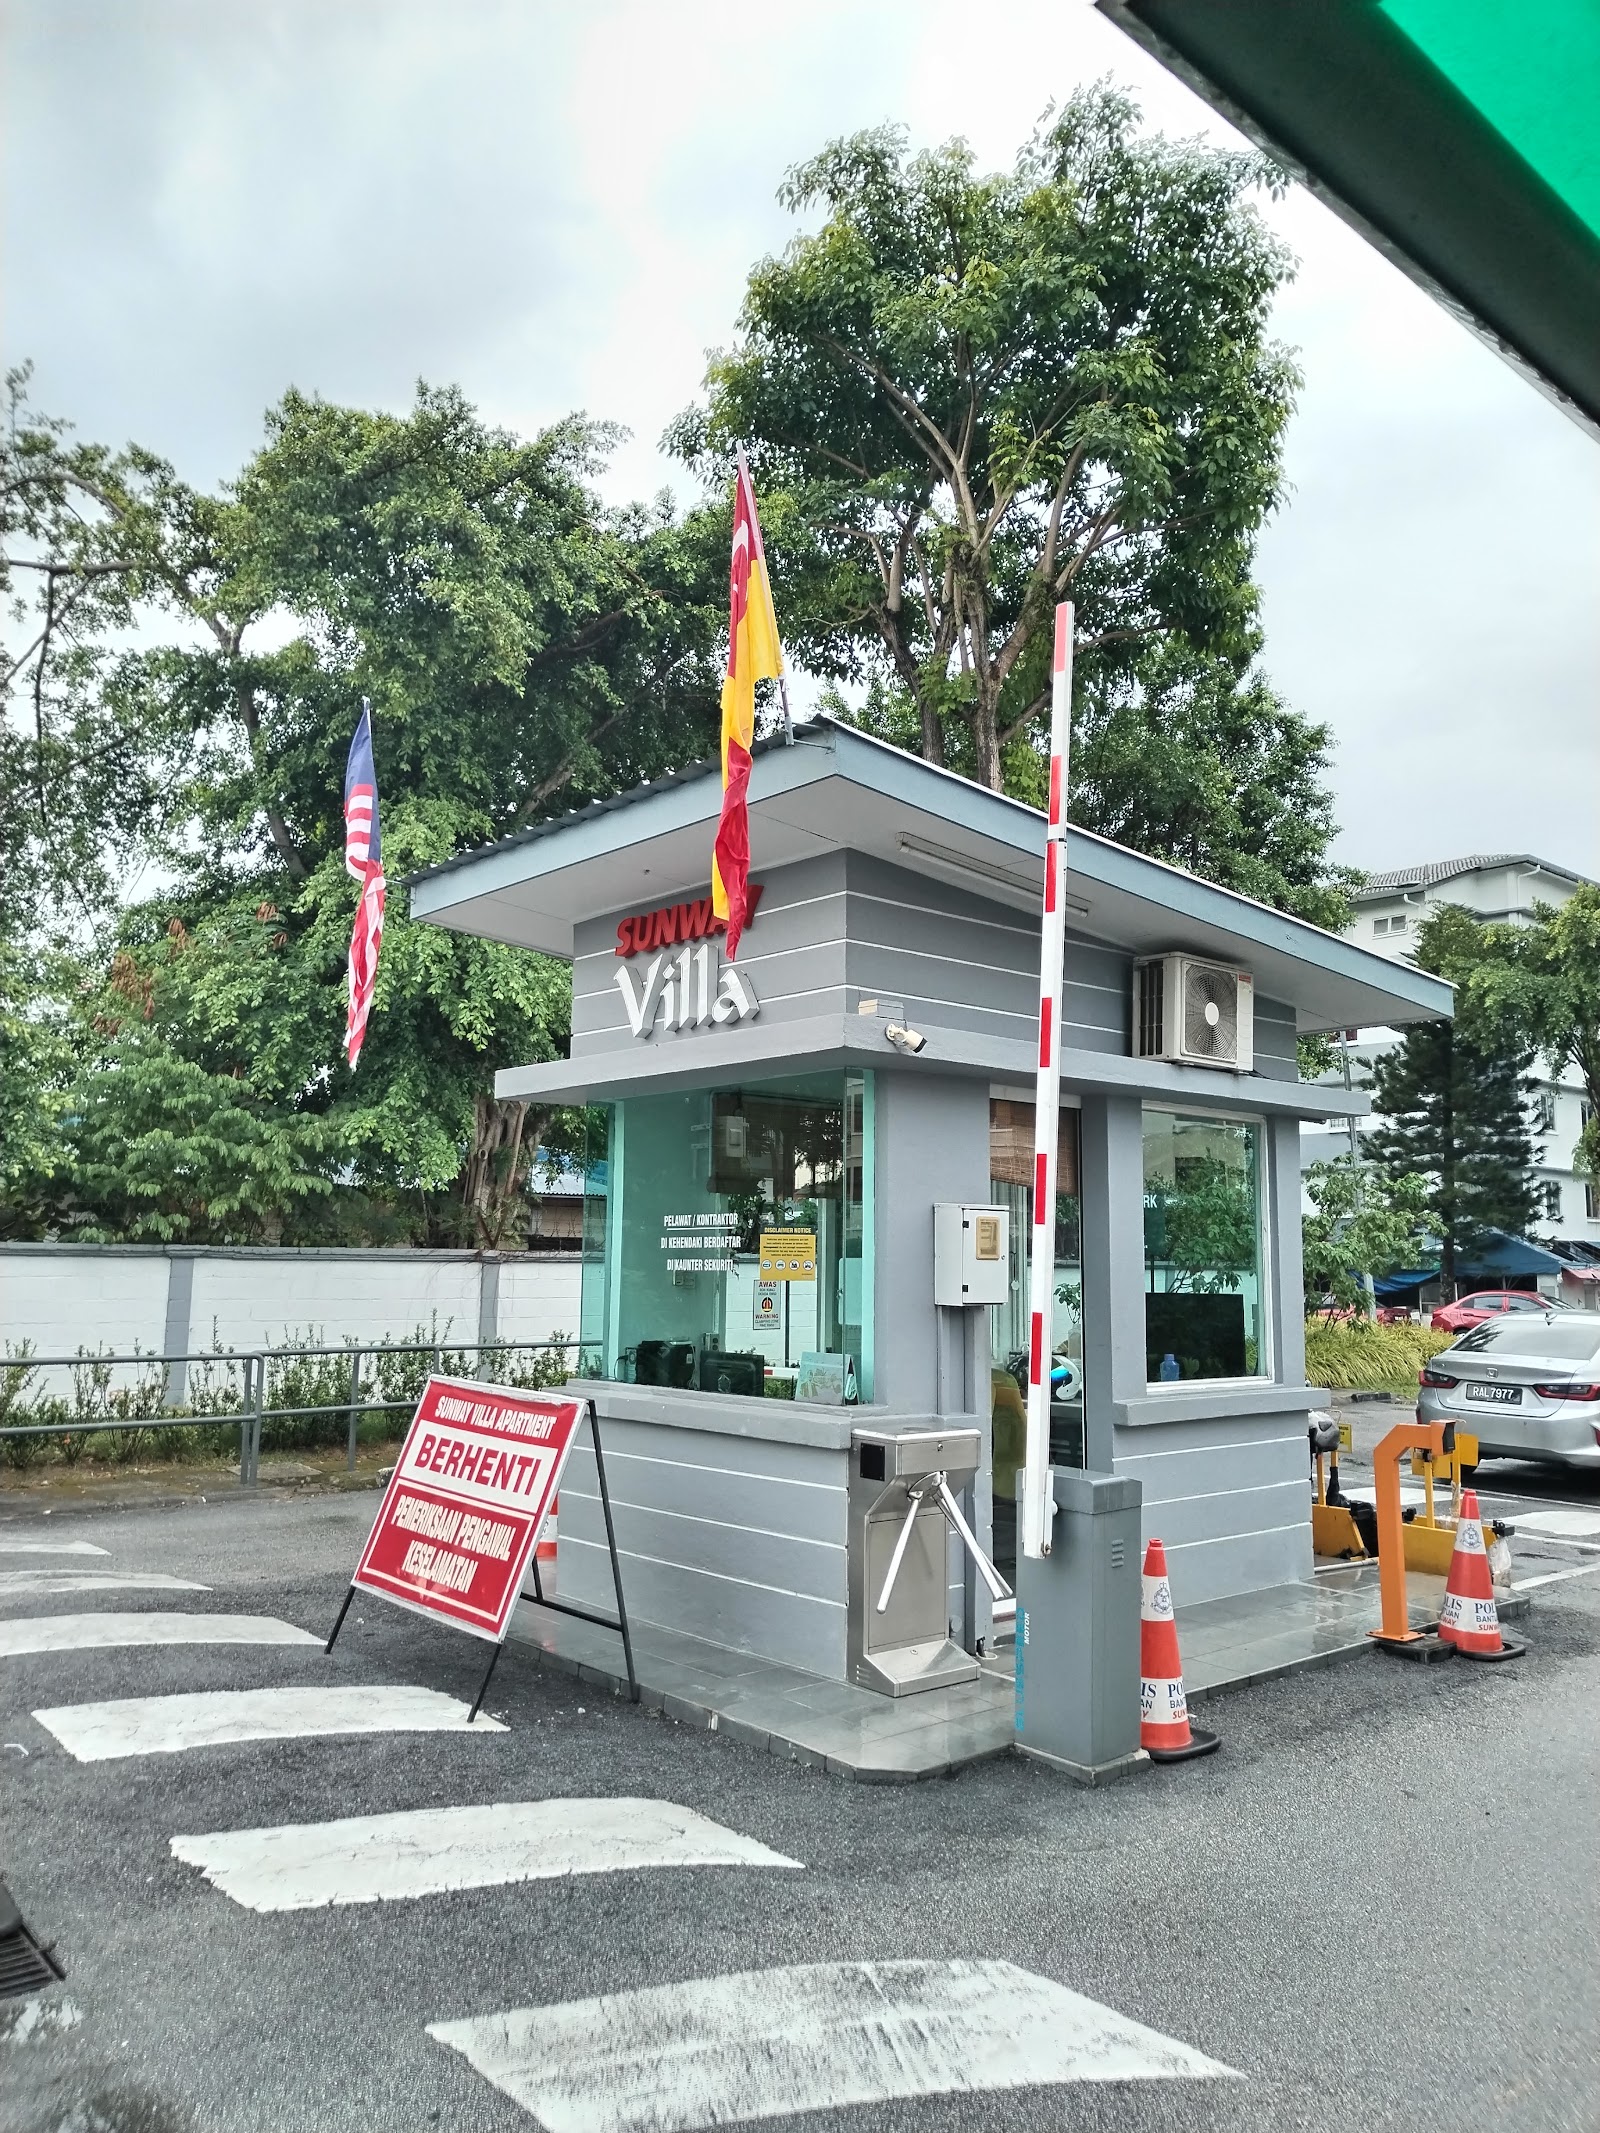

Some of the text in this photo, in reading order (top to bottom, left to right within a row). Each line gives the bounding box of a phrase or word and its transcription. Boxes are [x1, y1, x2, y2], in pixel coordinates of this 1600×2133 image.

[613, 944, 760, 1039] Villa
[661, 1235, 741, 1249] DI KEHENDAKI BERDAFTAR
[664, 1212, 739, 1227] PELAWAT / KONTRAKTOR
[667, 1259, 734, 1271] DI KAUNTER SEKURITI
[1472, 1386, 1514, 1400] RAL 7977
[434, 1395, 557, 1440] SUNWAY VILLA APARTMENT
[414, 1433, 542, 1496] BERHENTI
[390, 1494, 517, 1562] PEMERIKSAAN PENGAWAL
[401, 1539, 479, 1594] KESELAMATAN
